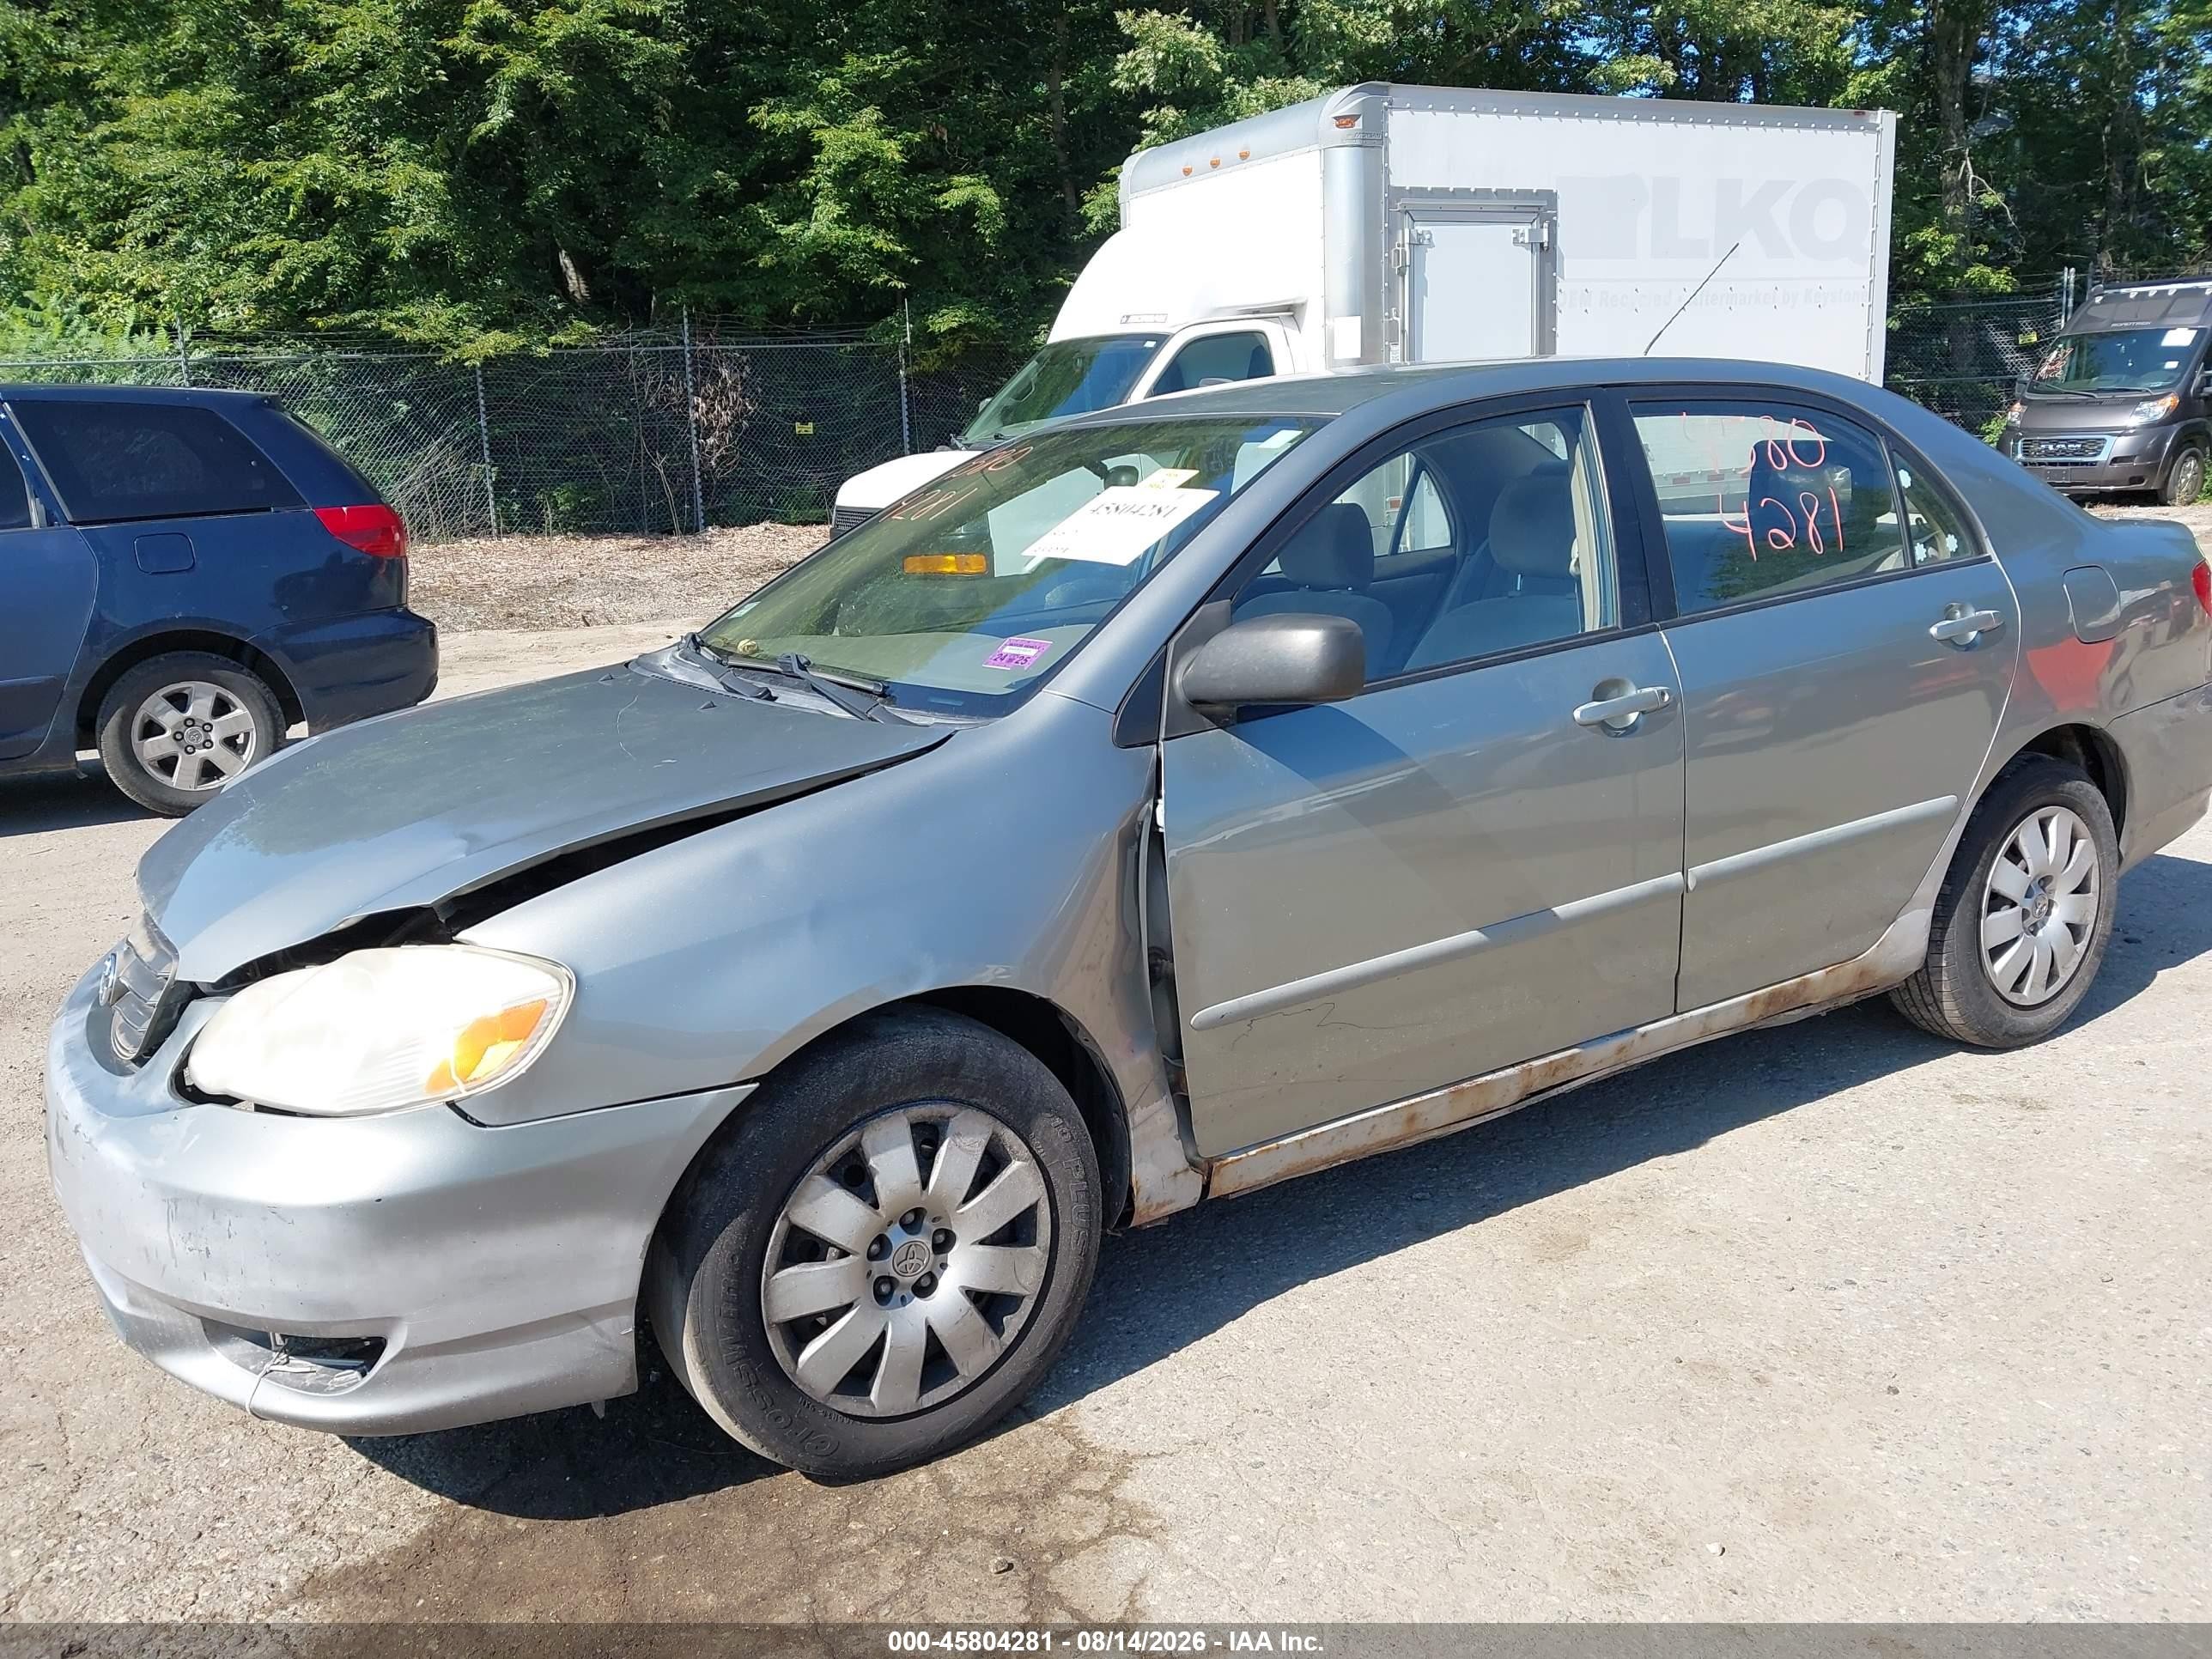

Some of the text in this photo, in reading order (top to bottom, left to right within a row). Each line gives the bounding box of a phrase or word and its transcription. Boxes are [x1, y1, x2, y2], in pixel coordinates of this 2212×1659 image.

[1650, 176, 1871, 267] LKQ
[1782, 288, 1797, 309] by
[1803, 287, 1868, 307] Keystone
[1719, 486, 1843, 562] 4281
[1015, 655, 1030, 665] 25
[1061, 1156, 1091, 1257] PLUS
